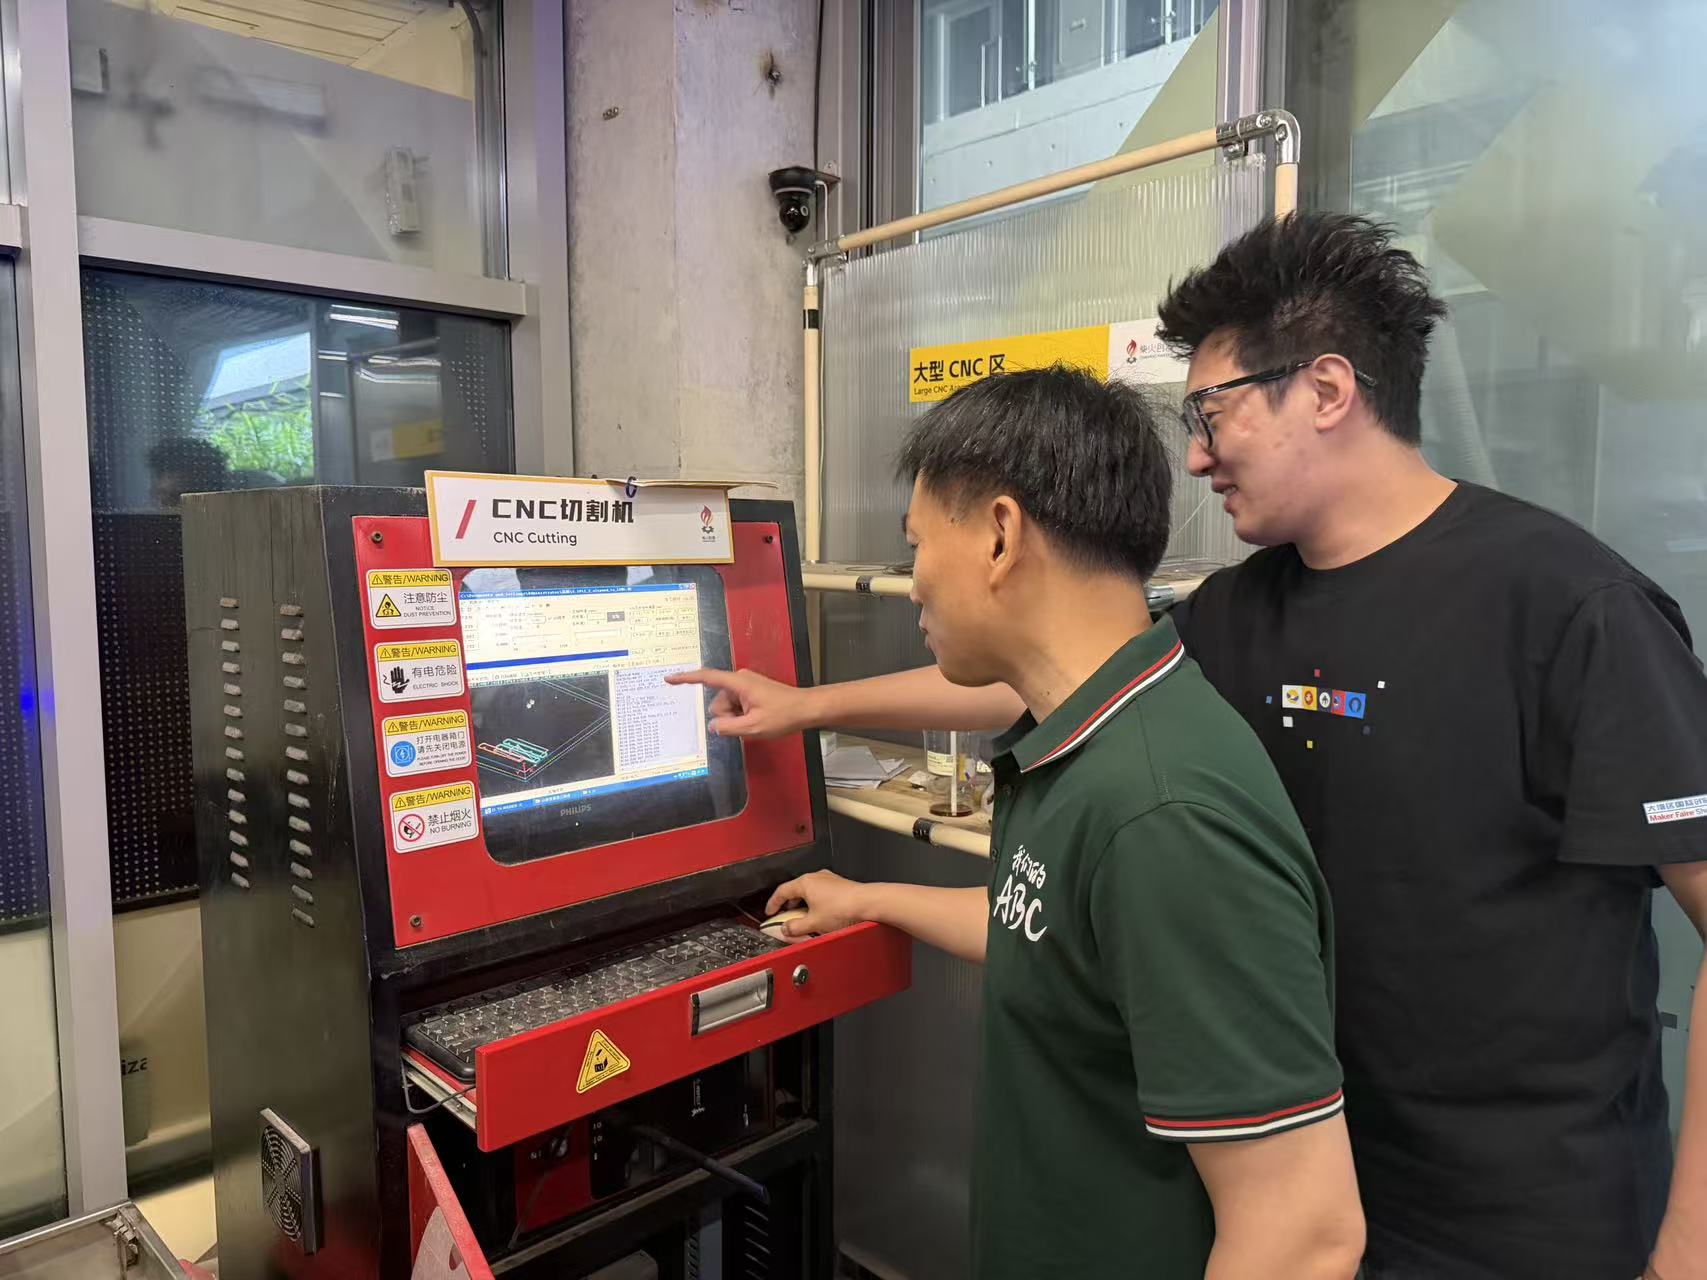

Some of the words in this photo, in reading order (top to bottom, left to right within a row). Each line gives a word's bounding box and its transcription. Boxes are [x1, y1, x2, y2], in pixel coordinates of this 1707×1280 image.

[913, 360, 944, 384] 大型
[949, 358, 984, 378] CNC
[990, 354, 1005, 376] 区
[914, 388, 932, 396] Large
[933, 385, 948, 394] CNC
[491, 498, 635, 524] CNC切割机
[493, 532, 524, 544] CNC
[527, 532, 578, 546] Cutting
[382, 573, 449, 585] 警告/WARNING
[403, 592, 449, 604] 注意防尘
[391, 644, 457, 658] 警告/WARNING
[411, 664, 457, 678] 有电危险
[398, 715, 465, 731] 警告/WARNING
[417, 741, 466, 754] 请先关闭电源
[405, 786, 471, 807] 警告/WARNING
[427, 807, 472, 827] 禁止烟火
[560, 803, 592, 817] PHILIPS
[1649, 813, 1674, 822] Maker
[1674, 810, 1695, 818] Faire
[441, 822, 472, 832] BURNING
[993, 874, 1048, 942] ABC
